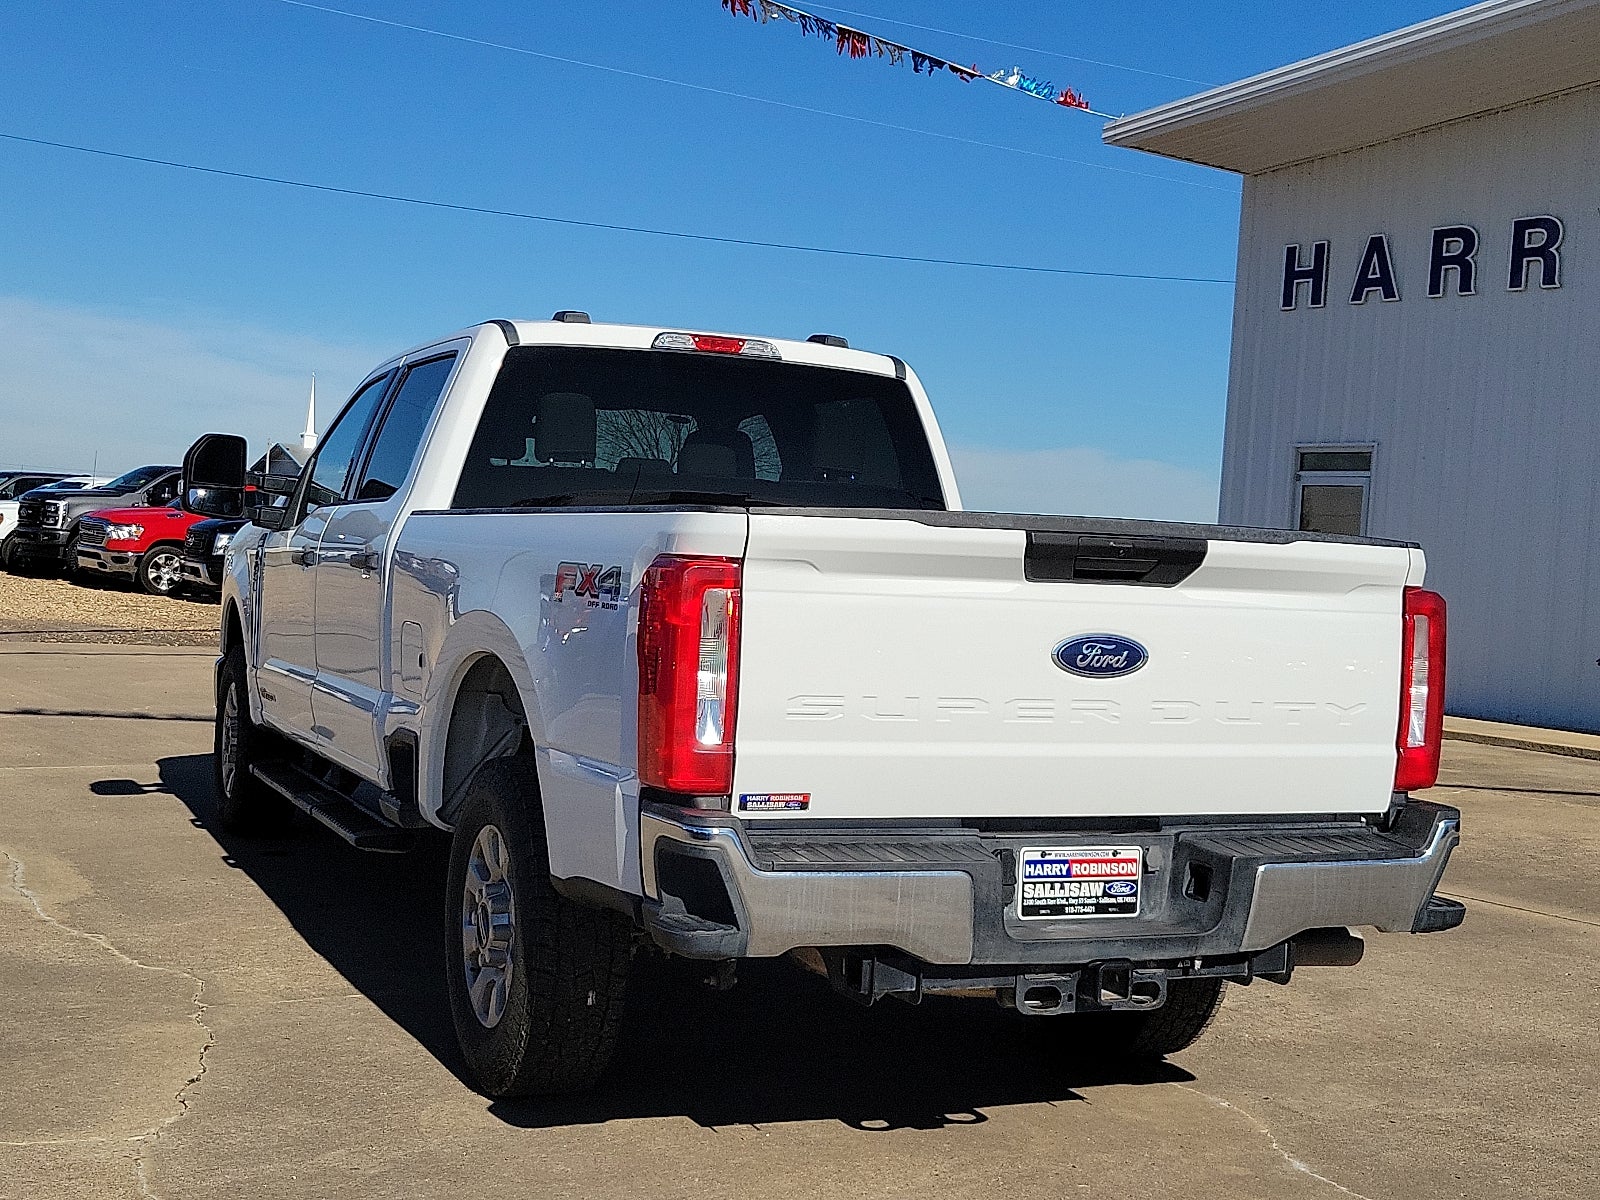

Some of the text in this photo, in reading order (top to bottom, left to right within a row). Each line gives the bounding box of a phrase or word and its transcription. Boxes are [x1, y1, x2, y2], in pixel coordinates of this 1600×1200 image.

[1280, 208, 1600, 311] HARR
[555, 560, 622, 602] FX4
[587, 600, 619, 611] OFF ROAD
[1076, 642, 1129, 668] Ford
[785, 694, 1367, 726] SUPER DUTY
[1025, 861, 1137, 877] HARRY ROBINSON
[1023, 881, 1105, 898] SALLISAW
